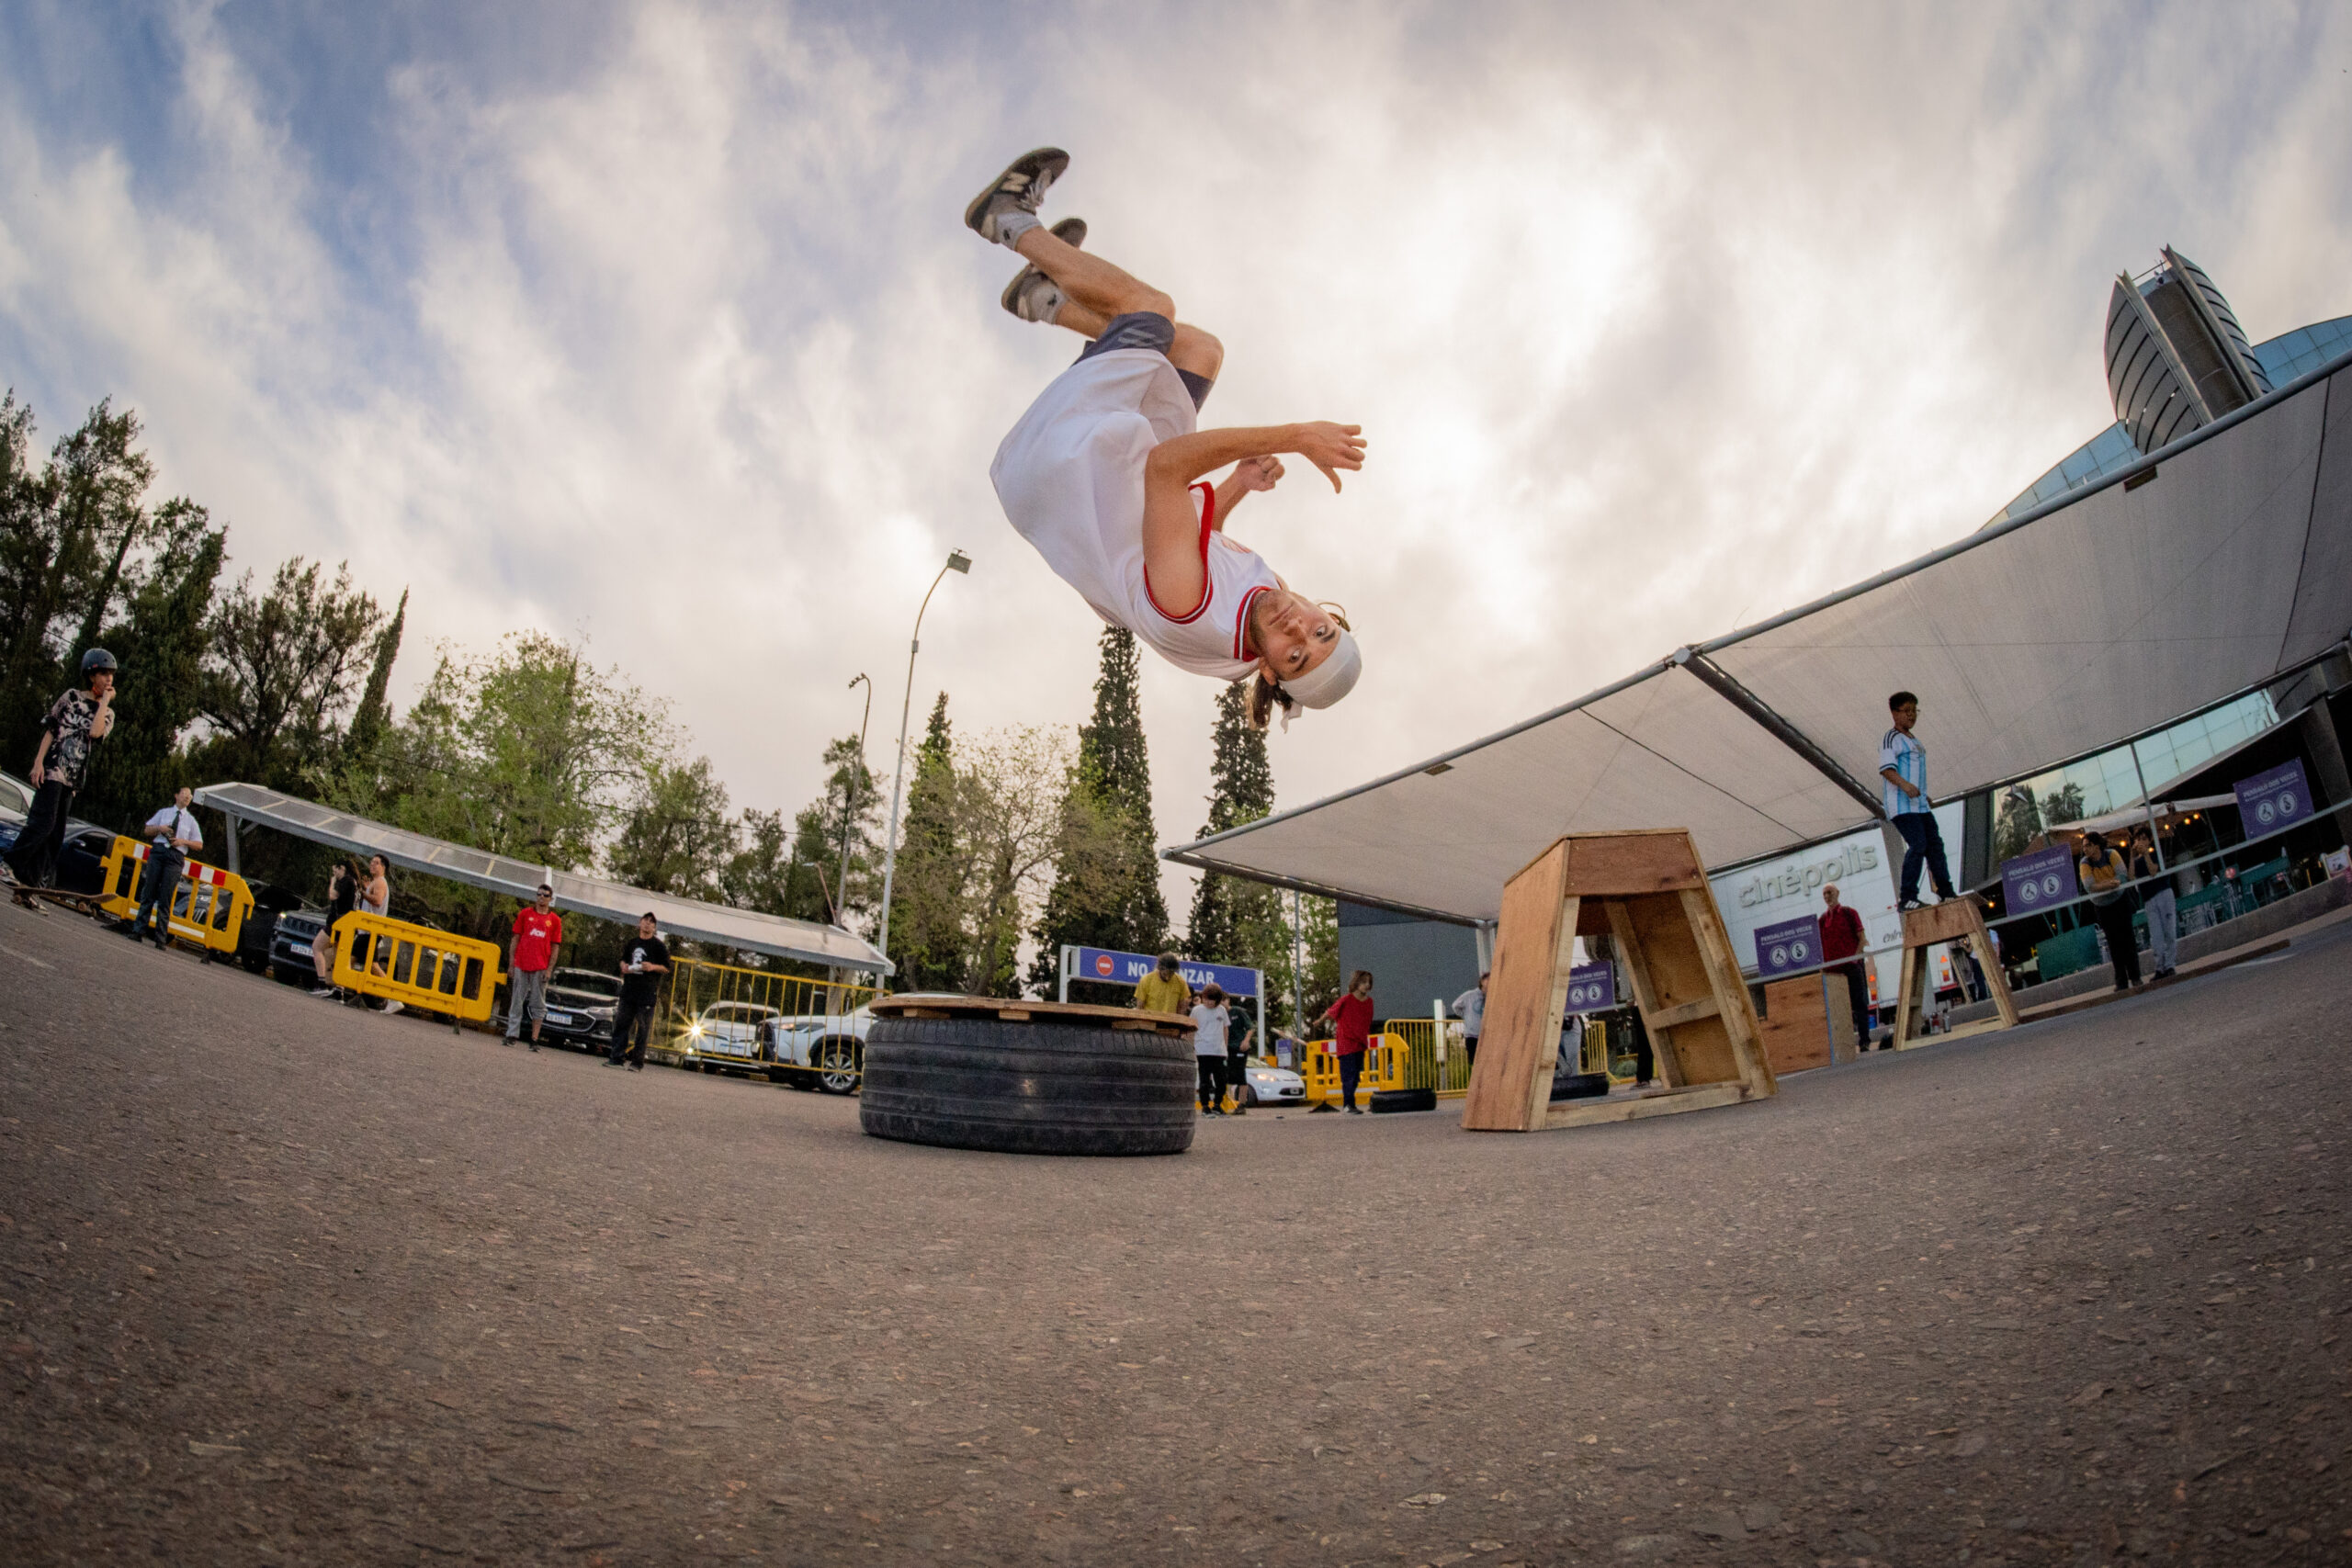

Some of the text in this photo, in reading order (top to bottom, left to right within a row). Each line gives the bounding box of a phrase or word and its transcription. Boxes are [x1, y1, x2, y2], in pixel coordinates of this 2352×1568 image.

[1739, 843, 1879, 908] cinépolis
[1784, 929, 1796, 937] DOS
[1127, 961, 1215, 985] NO NZAR
